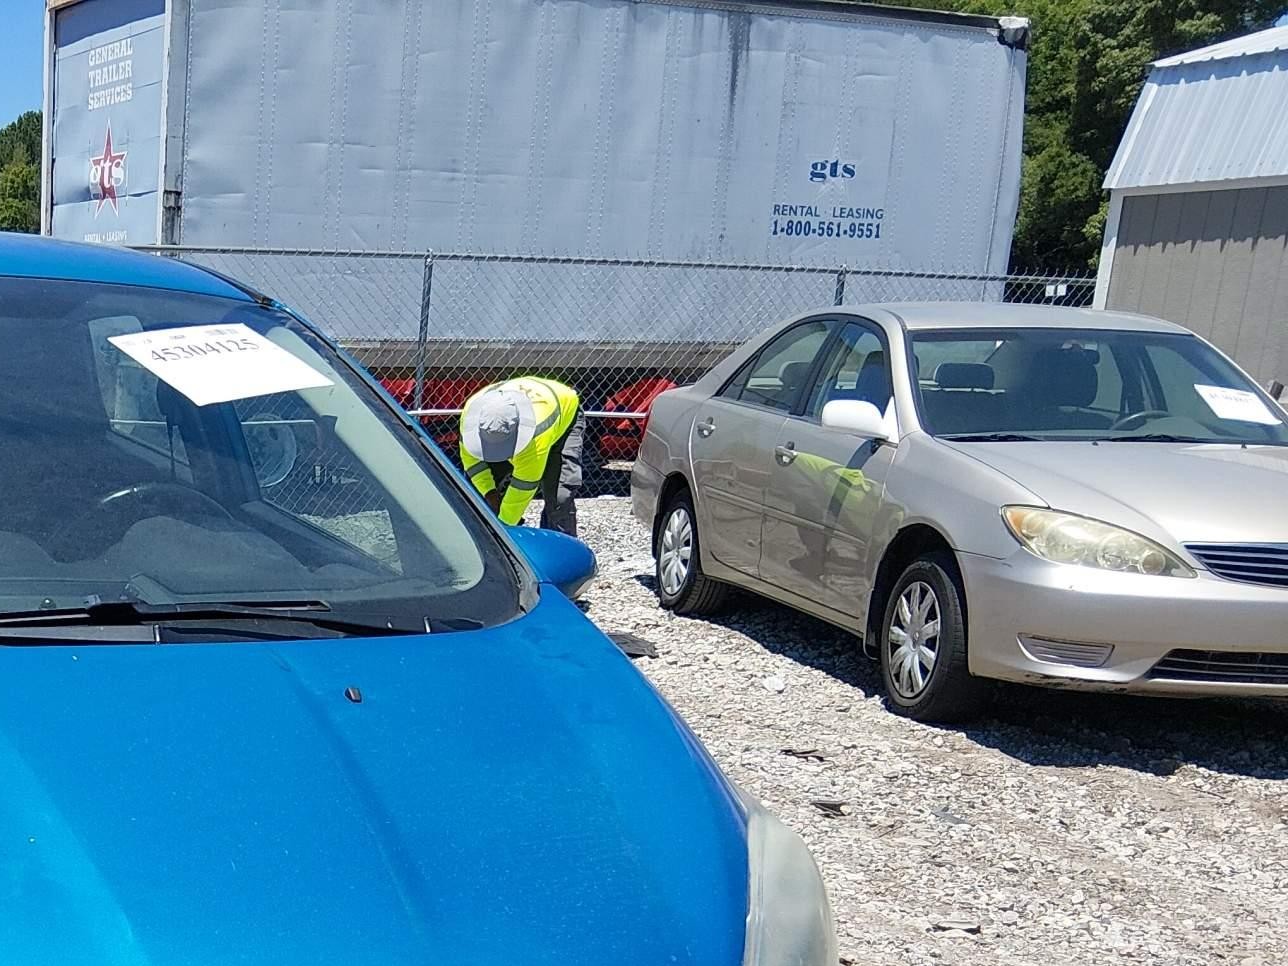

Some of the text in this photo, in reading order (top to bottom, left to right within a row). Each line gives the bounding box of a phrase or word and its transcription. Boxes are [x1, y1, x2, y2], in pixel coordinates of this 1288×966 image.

[88, 38, 133, 66] GENERAL
[88, 60, 132, 88] TRAILER
[88, 83, 133, 110] SERVICES
[809, 159, 856, 183] gts
[773, 204, 884, 220] RENTAL LEASING
[772, 220, 881, 239] 1-800-561-9551
[151, 338, 260, 361] 45304125
